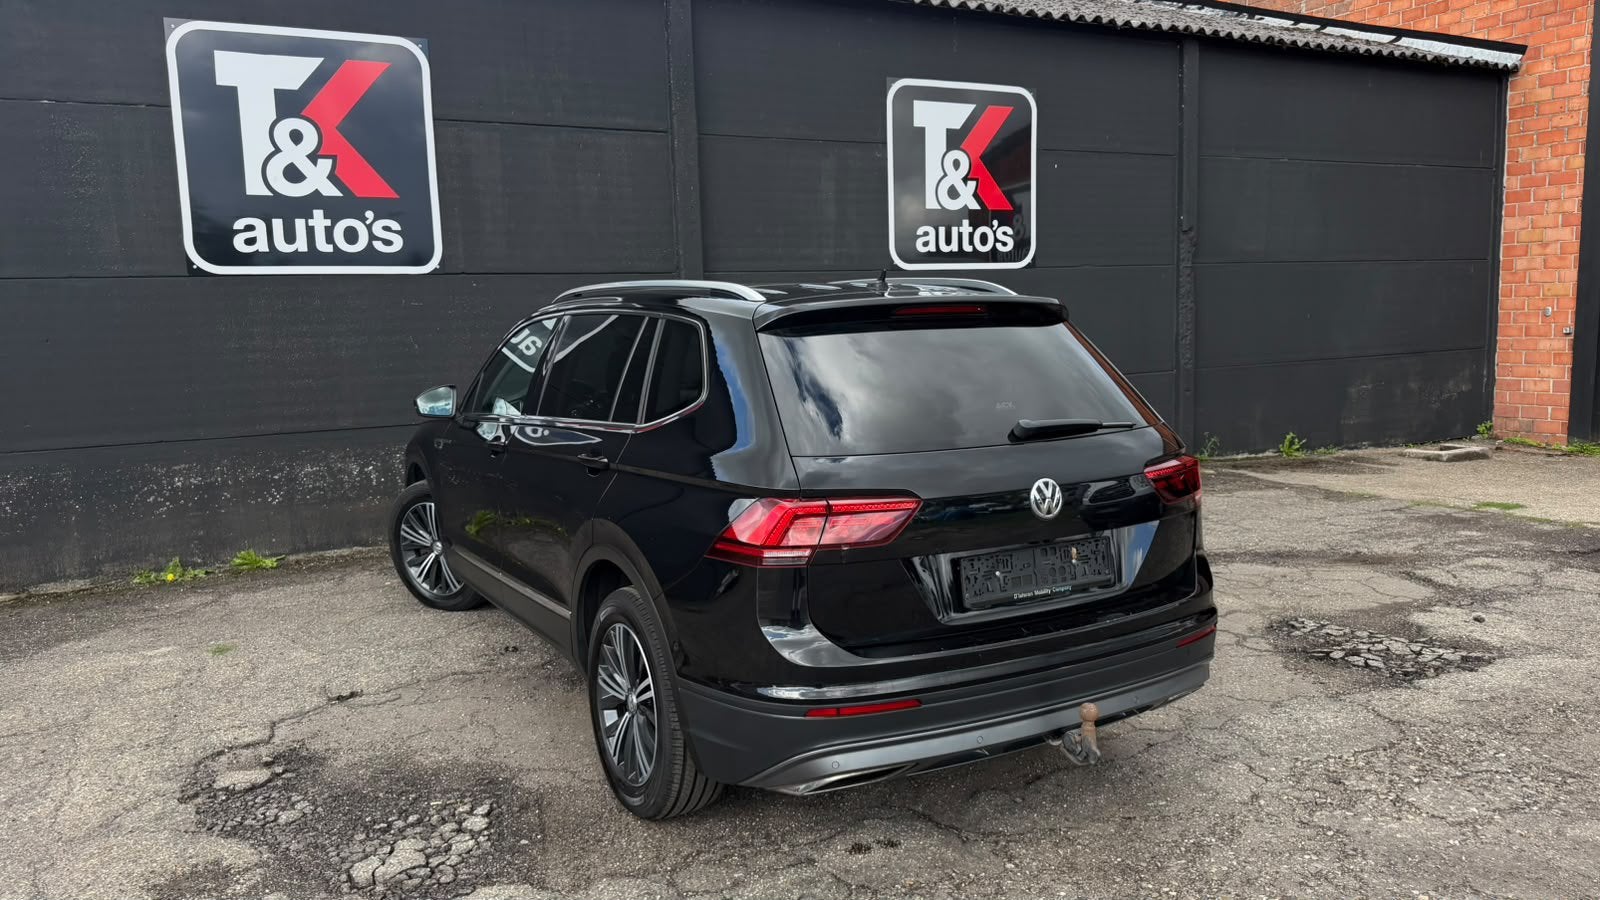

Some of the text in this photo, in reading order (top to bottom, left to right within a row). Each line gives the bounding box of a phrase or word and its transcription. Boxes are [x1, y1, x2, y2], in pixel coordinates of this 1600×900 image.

[213, 49, 400, 199] T&K
[913, 99, 1014, 211] T&K
[232, 209, 404, 253] auto's
[915, 219, 1014, 253] auto's
